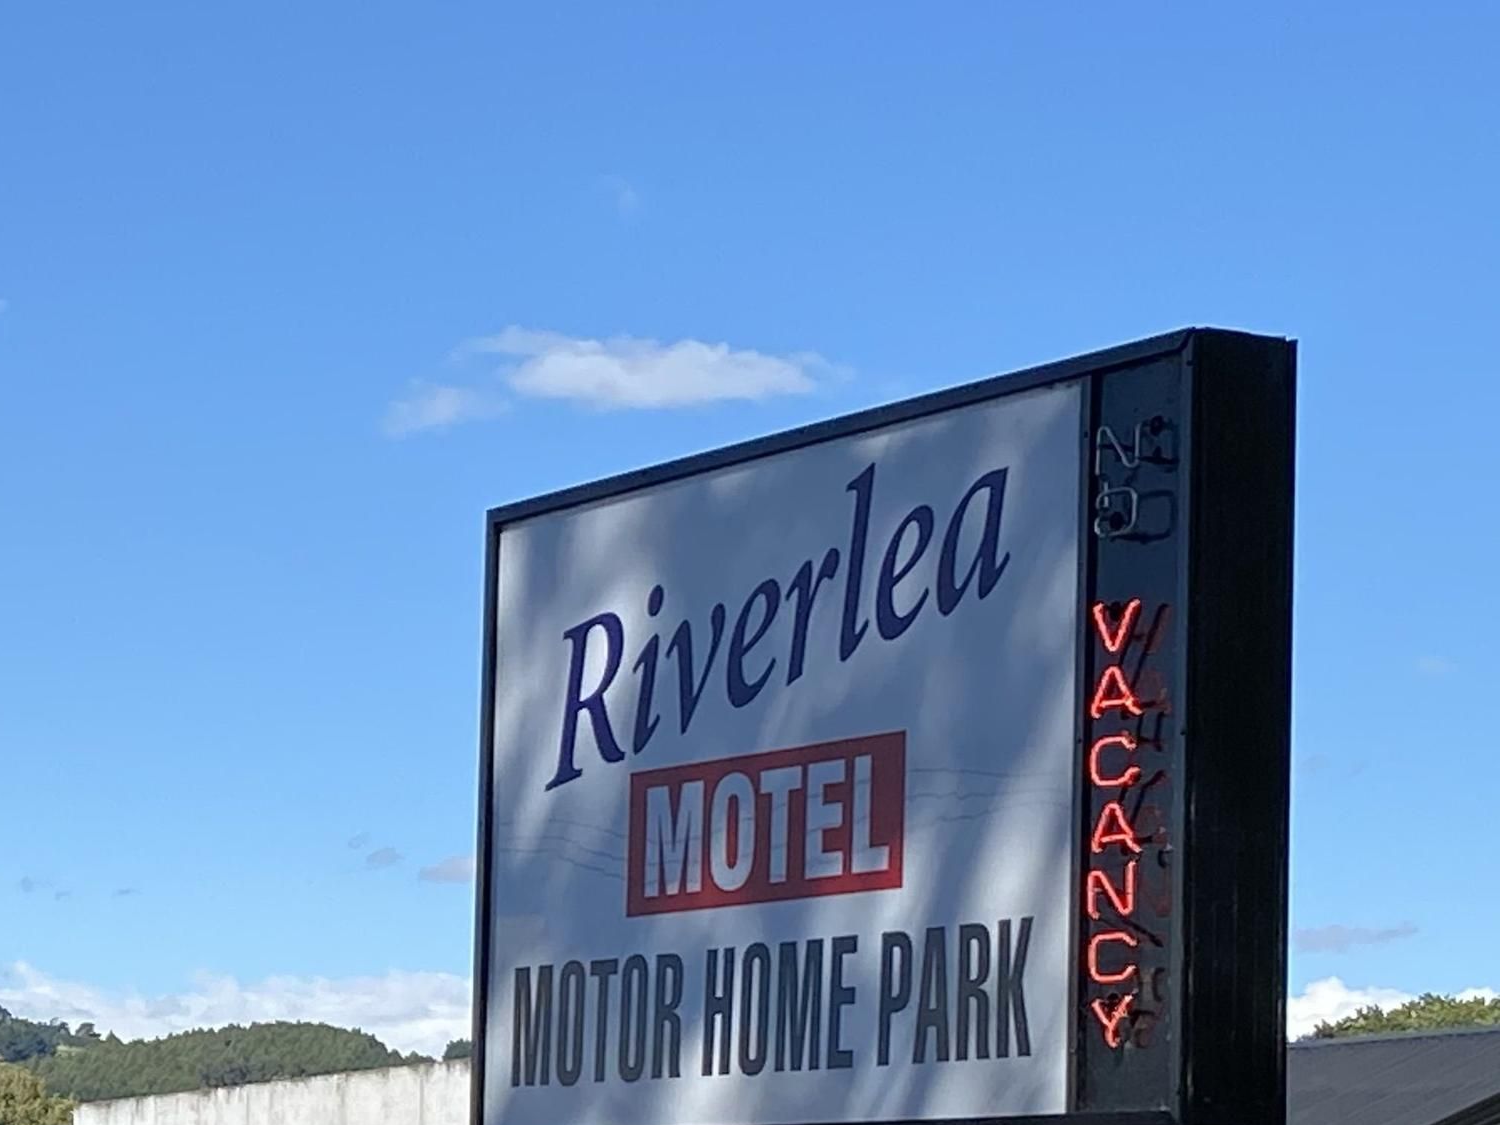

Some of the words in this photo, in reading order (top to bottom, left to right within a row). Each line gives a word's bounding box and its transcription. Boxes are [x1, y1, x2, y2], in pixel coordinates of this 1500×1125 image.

[545, 463, 1011, 792] Riverlea
[642, 753, 891, 899] MOTEL
[1088, 598, 1143, 1048] VACANCY
[510, 952, 683, 1087] MOTOR
[704, 935, 859, 1078] HOME
[878, 916, 1035, 1067] PARK
